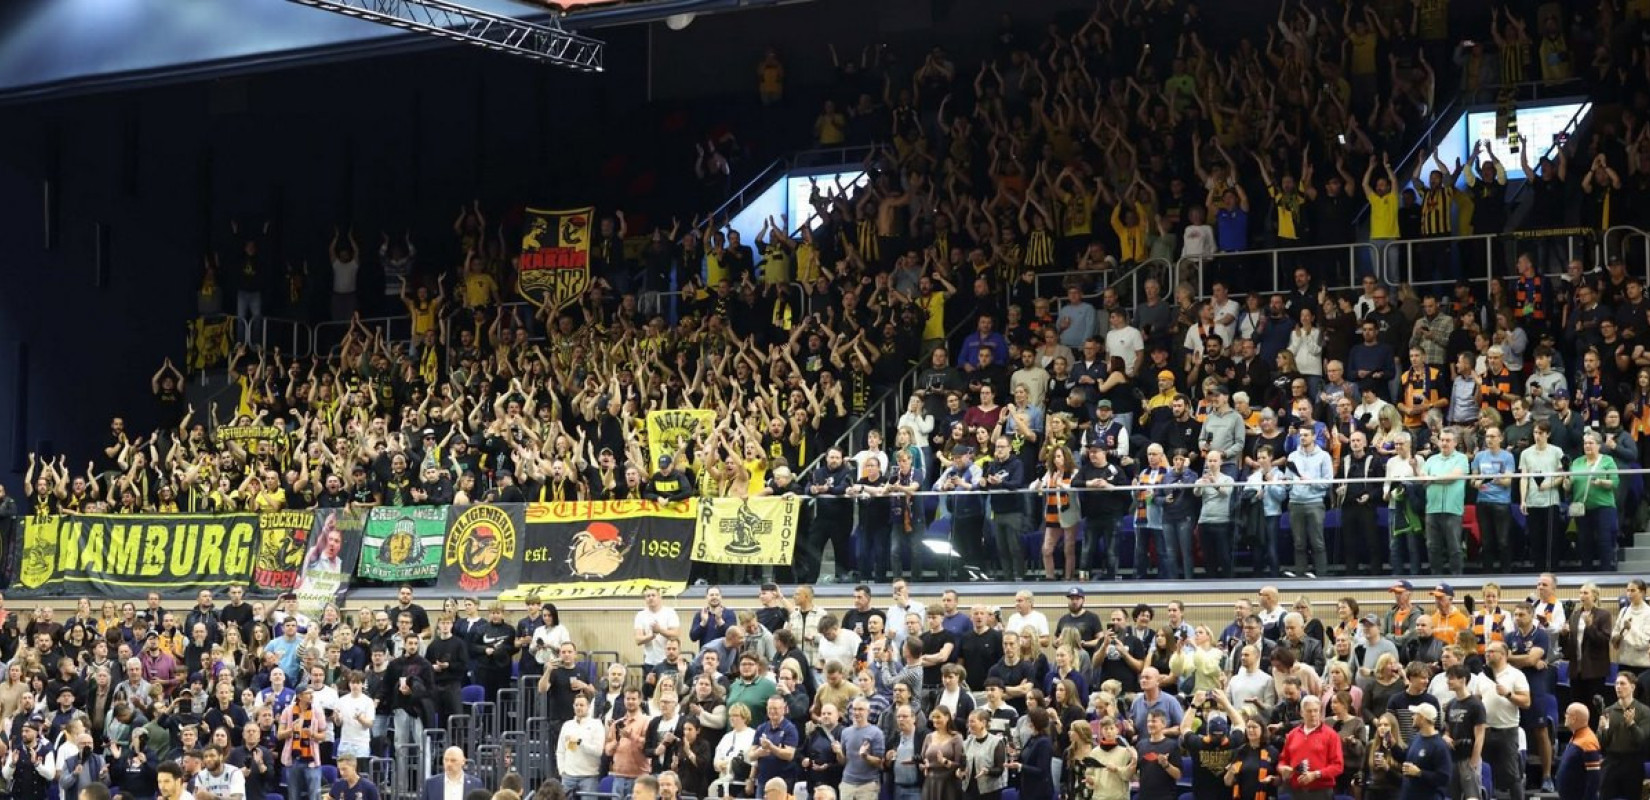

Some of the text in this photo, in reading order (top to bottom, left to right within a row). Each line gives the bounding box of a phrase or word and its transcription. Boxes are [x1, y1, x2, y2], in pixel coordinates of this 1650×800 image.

[58, 522, 253, 576] HAMBURG
[524, 546, 552, 562] est.
[641, 539, 681, 558] 1988
